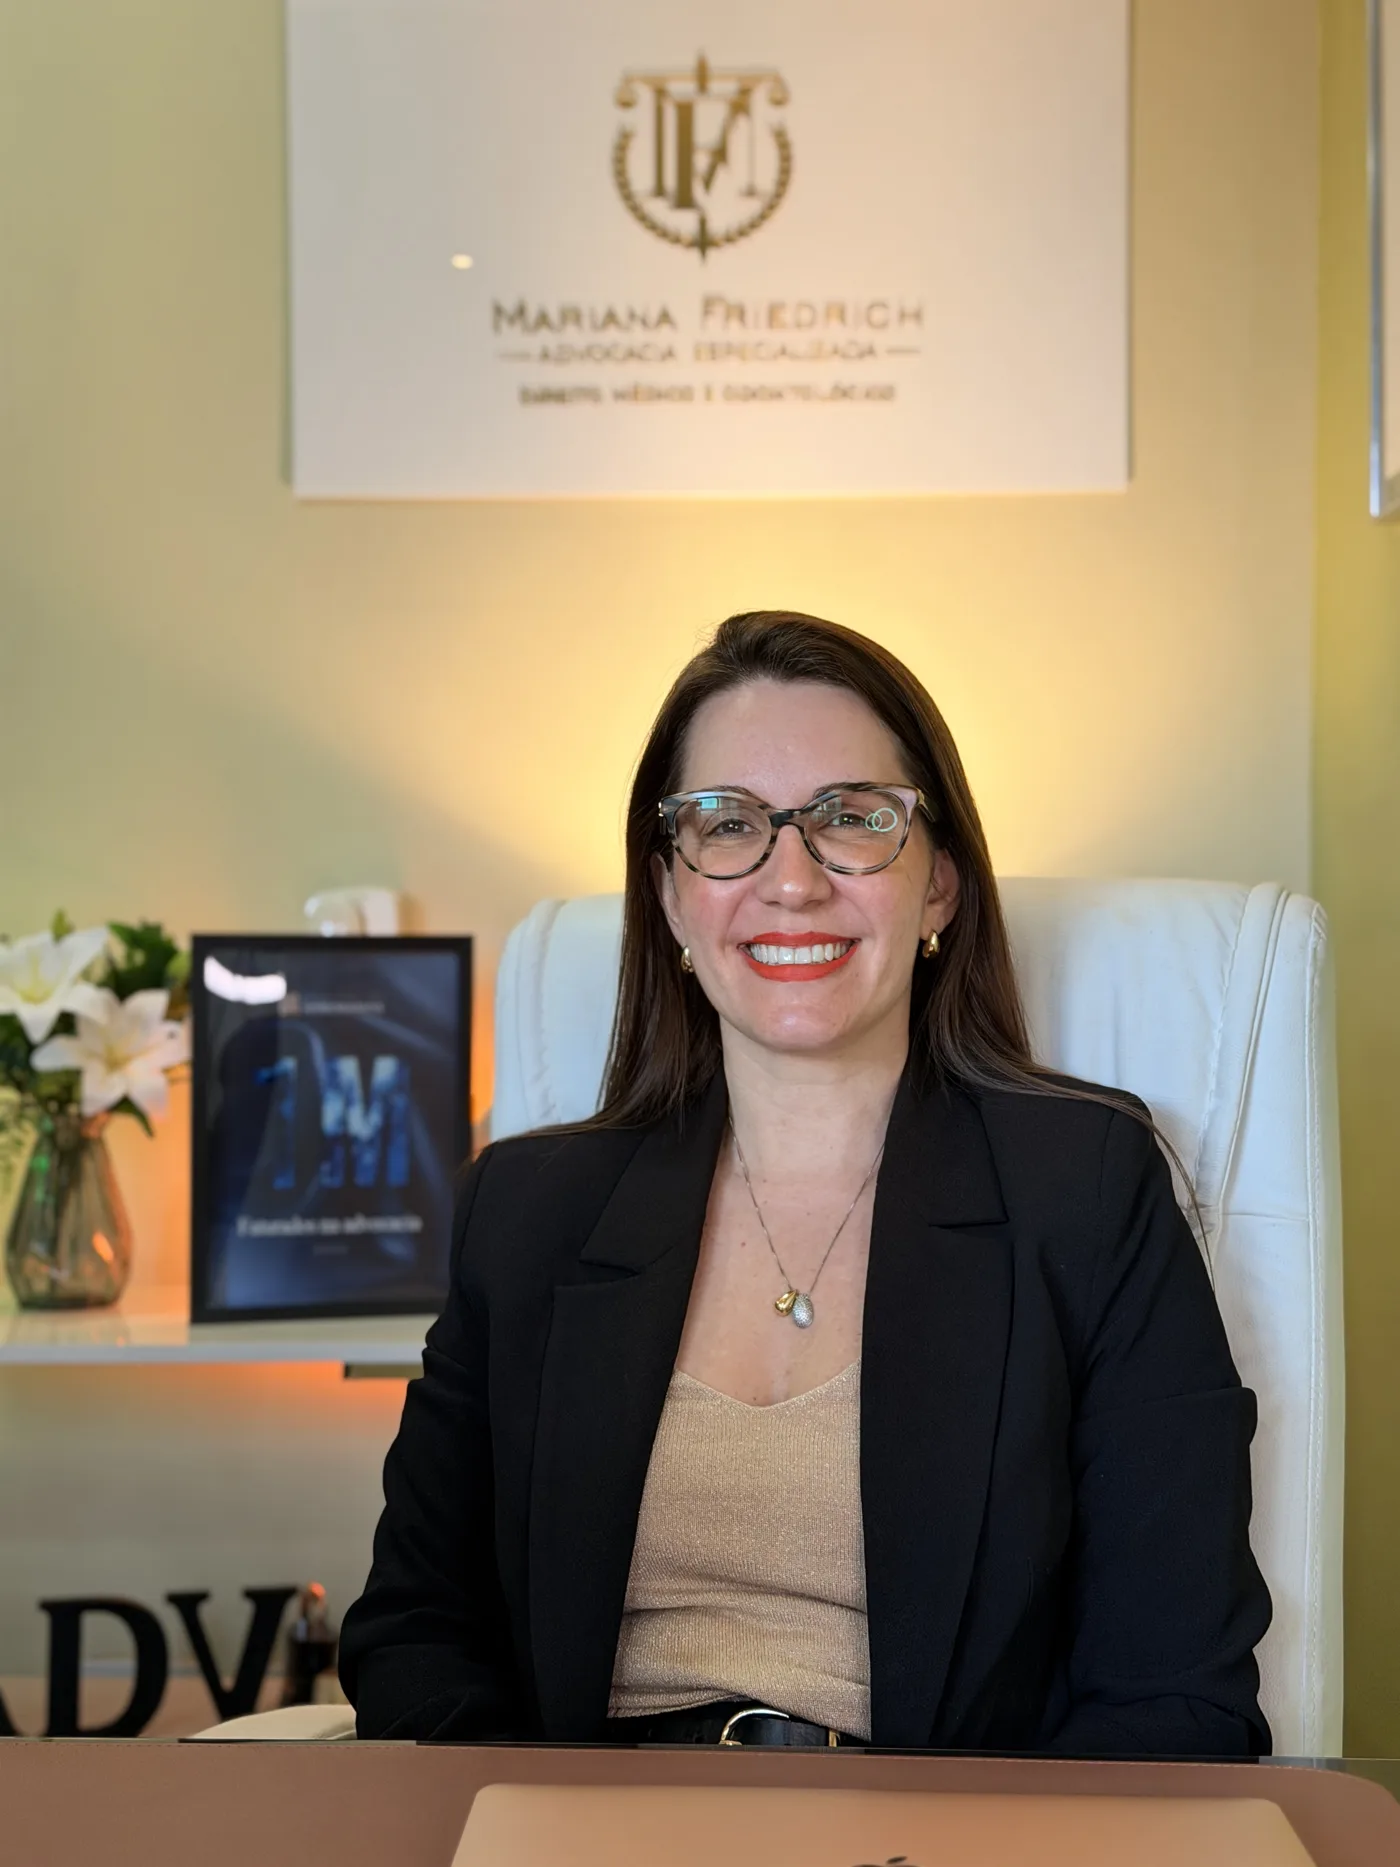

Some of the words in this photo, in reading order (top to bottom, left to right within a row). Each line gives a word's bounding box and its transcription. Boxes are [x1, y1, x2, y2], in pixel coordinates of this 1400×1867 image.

[492, 295, 676, 332] MARIANA
[700, 294, 923, 330] FRIEDRICH
[539, 343, 677, 364] ADVOCACIA
[0, 1585, 299, 1738] DV
